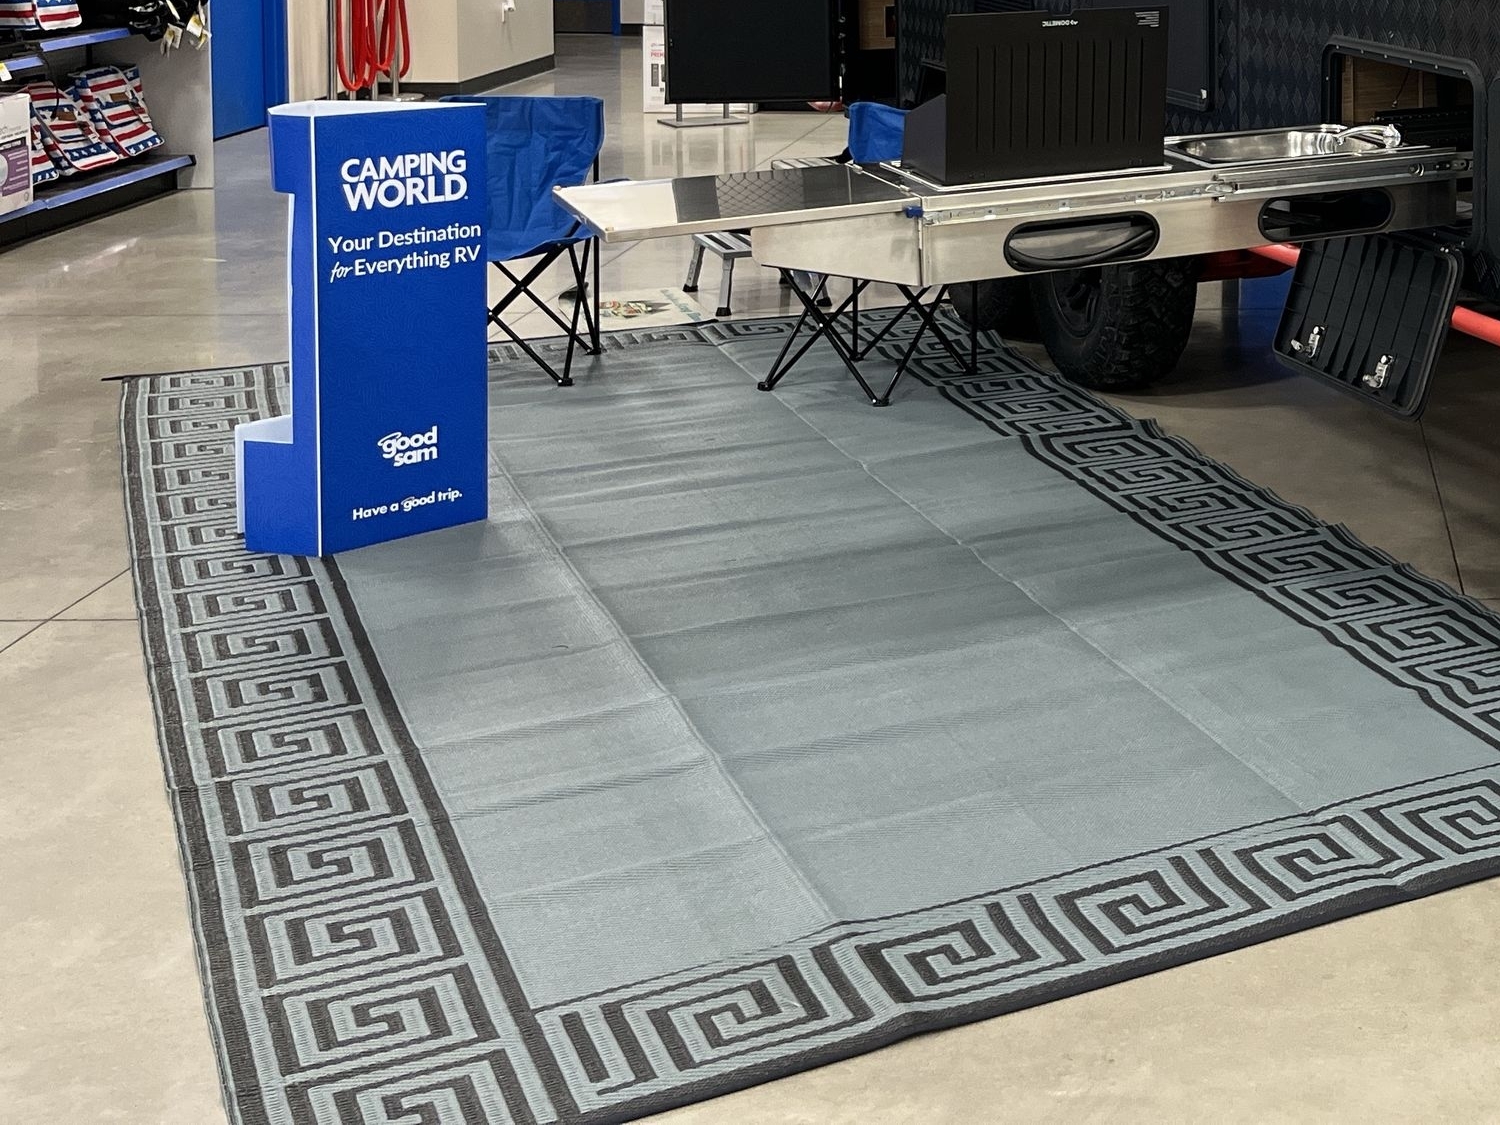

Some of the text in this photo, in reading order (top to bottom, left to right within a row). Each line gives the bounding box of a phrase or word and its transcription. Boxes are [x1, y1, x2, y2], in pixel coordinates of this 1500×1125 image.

[1042, 20, 1070, 28] DOMETIC
[341, 149, 467, 183] CAMPING
[342, 173, 468, 212] WORLD
[328, 223, 481, 254] Your Destination
[329, 244, 481, 284] for Everything RV
[377, 425, 438, 459] good
[393, 446, 438, 467] sam
[352, 487, 463, 521] Have a good trip.
